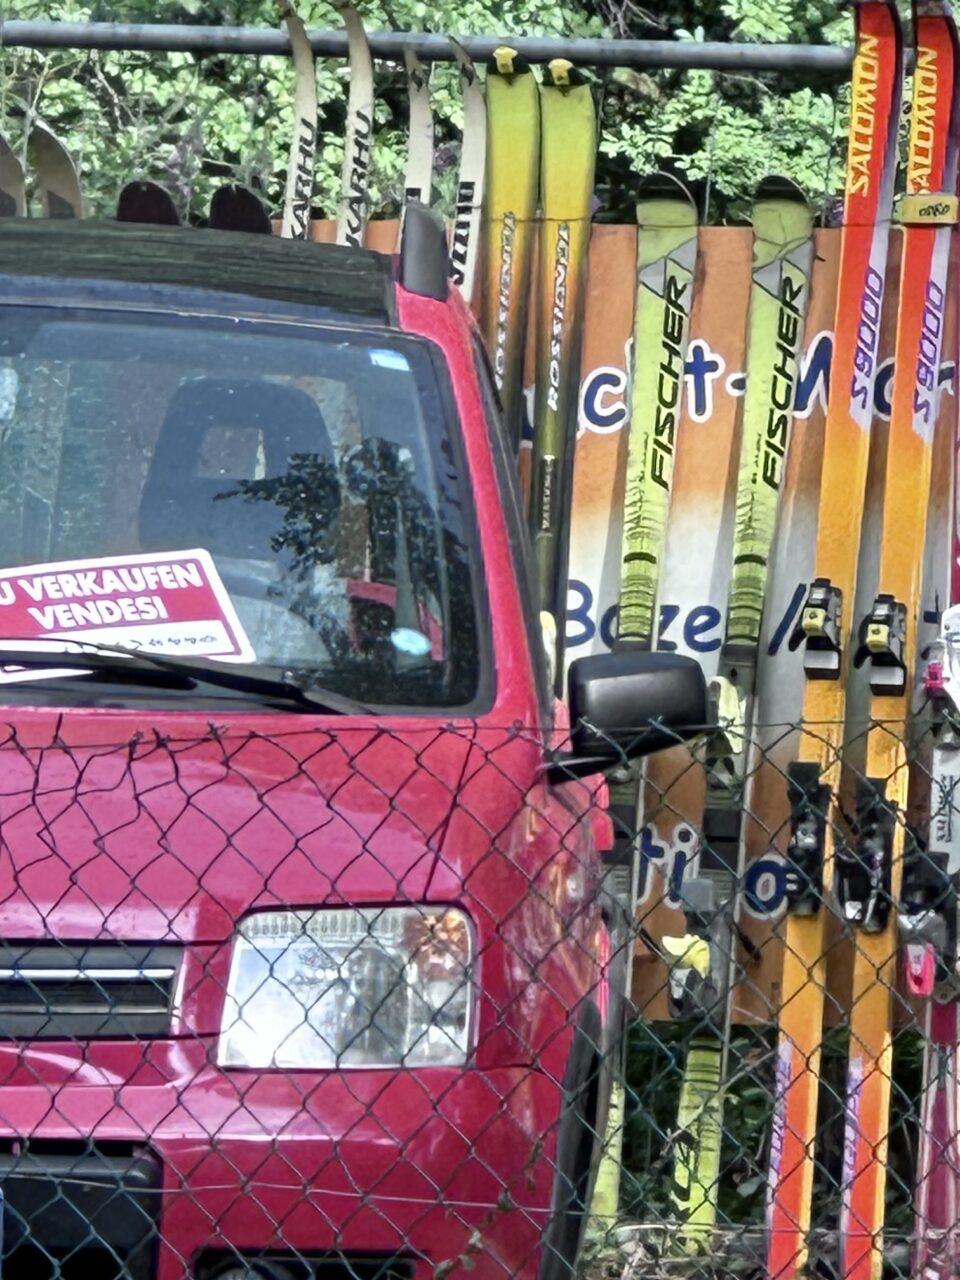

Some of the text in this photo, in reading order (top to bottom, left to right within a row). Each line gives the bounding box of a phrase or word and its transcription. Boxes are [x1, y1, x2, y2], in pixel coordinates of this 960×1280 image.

[346, 109, 371, 248] KARHU
[847, 31, 880, 198] SALOMON
[906, 46, 938, 194] ALOMON
[547, 222, 570, 412] ROSSIGNOL
[651, 275, 689, 492] FISCHER
[763, 275, 804, 491] FISCHER
[851, 265, 883, 410] S9000
[914, 279, 945, 424] S9000
[17, 562, 204, 602] VERKAUFEN
[27, 595, 169, 630] VENDESI
